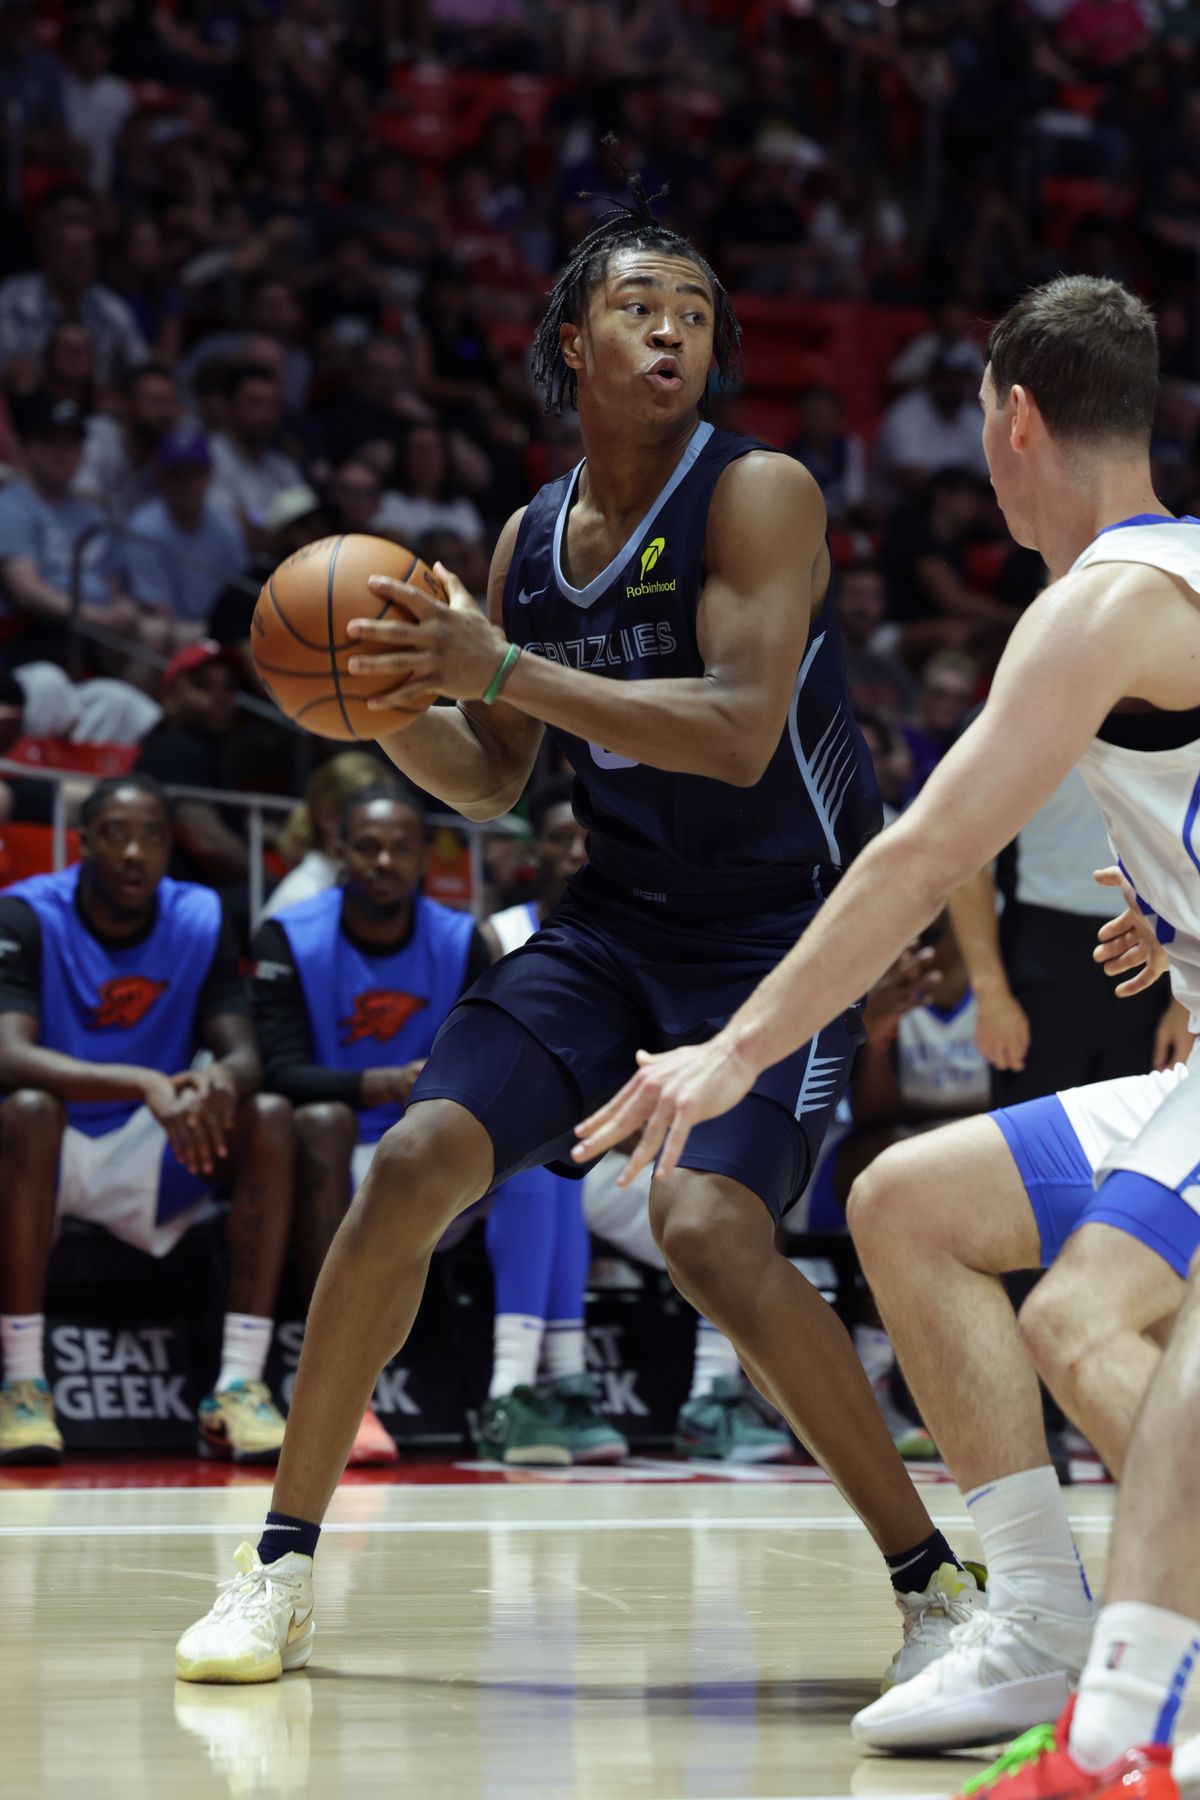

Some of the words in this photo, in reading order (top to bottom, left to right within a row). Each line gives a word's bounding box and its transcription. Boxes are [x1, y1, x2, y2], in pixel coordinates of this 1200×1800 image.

[626, 579, 676, 598] Robinhood
[51, 1326, 175, 1372] SEAT
[54, 1375, 194, 1421] GEEK
